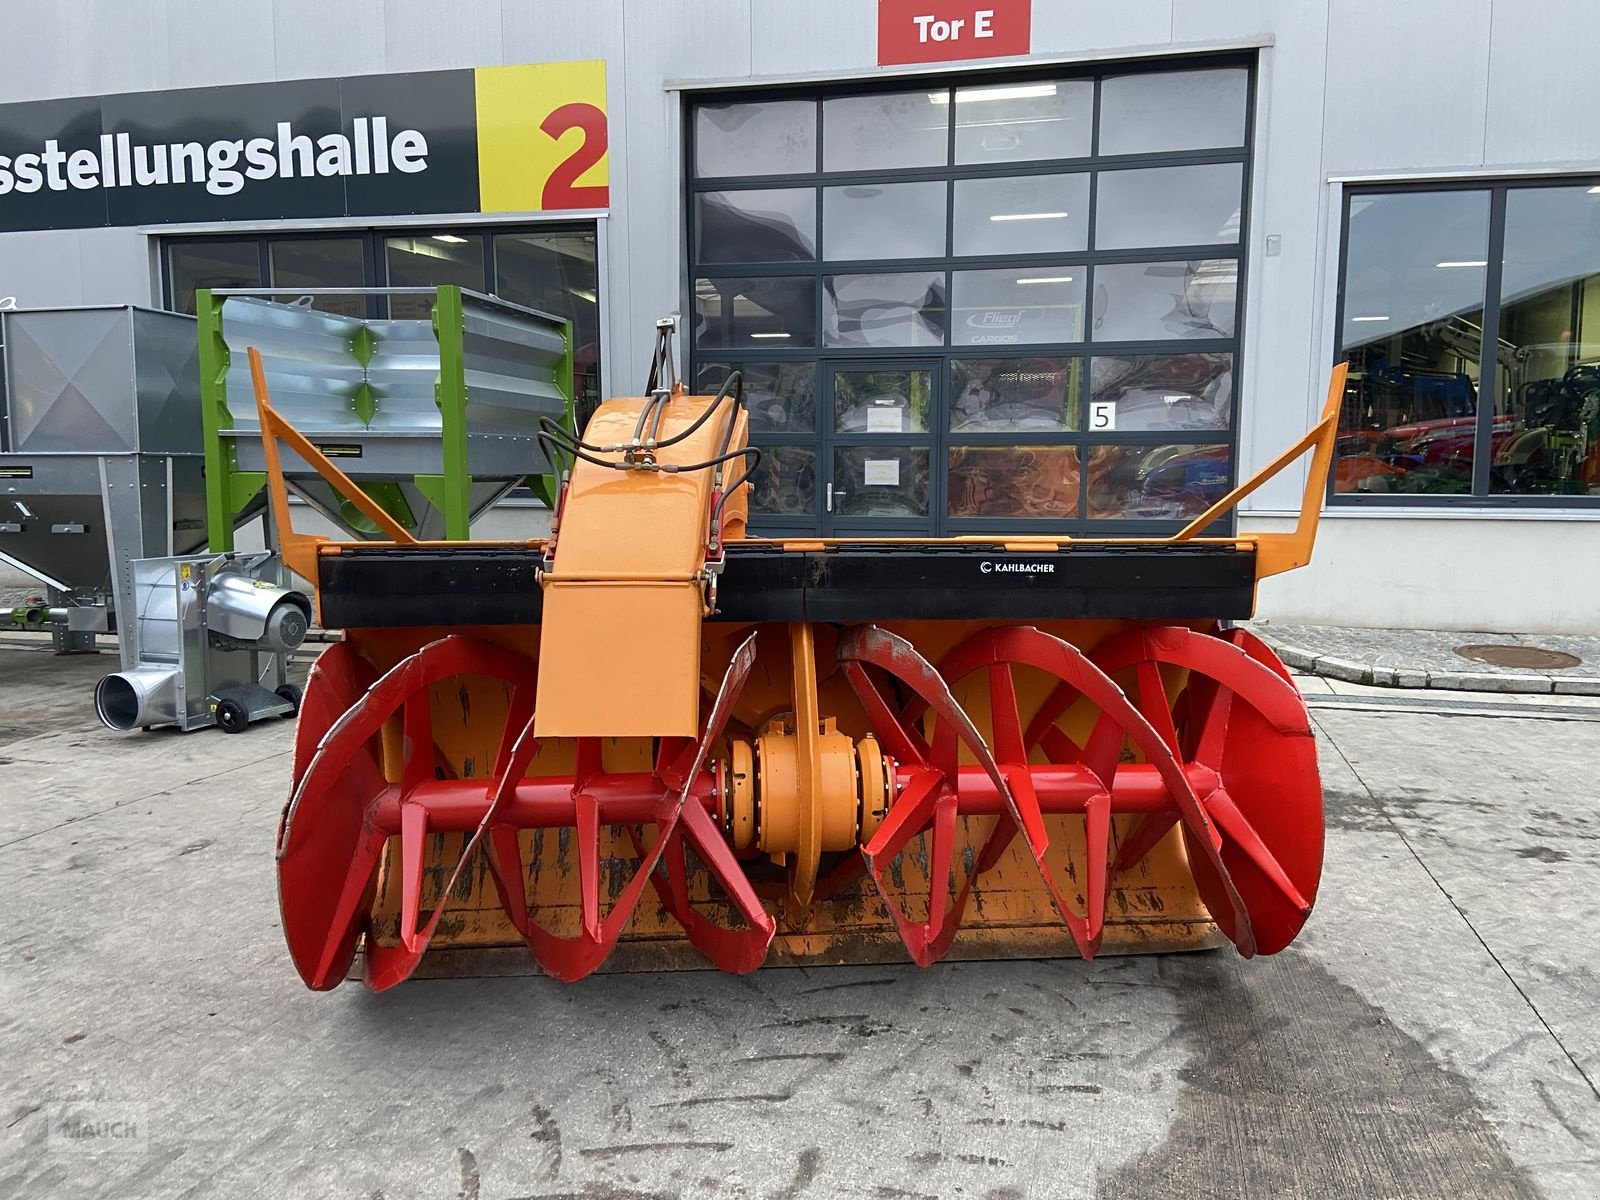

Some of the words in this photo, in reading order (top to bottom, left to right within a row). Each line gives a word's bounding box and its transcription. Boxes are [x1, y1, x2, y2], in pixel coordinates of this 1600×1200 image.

[912, 15, 965, 43] Tor
[974, 9, 994, 38] E
[539, 102, 609, 210] 2
[1094, 406, 1109, 428] 5
[994, 563, 1055, 573] KAHLBACHER
